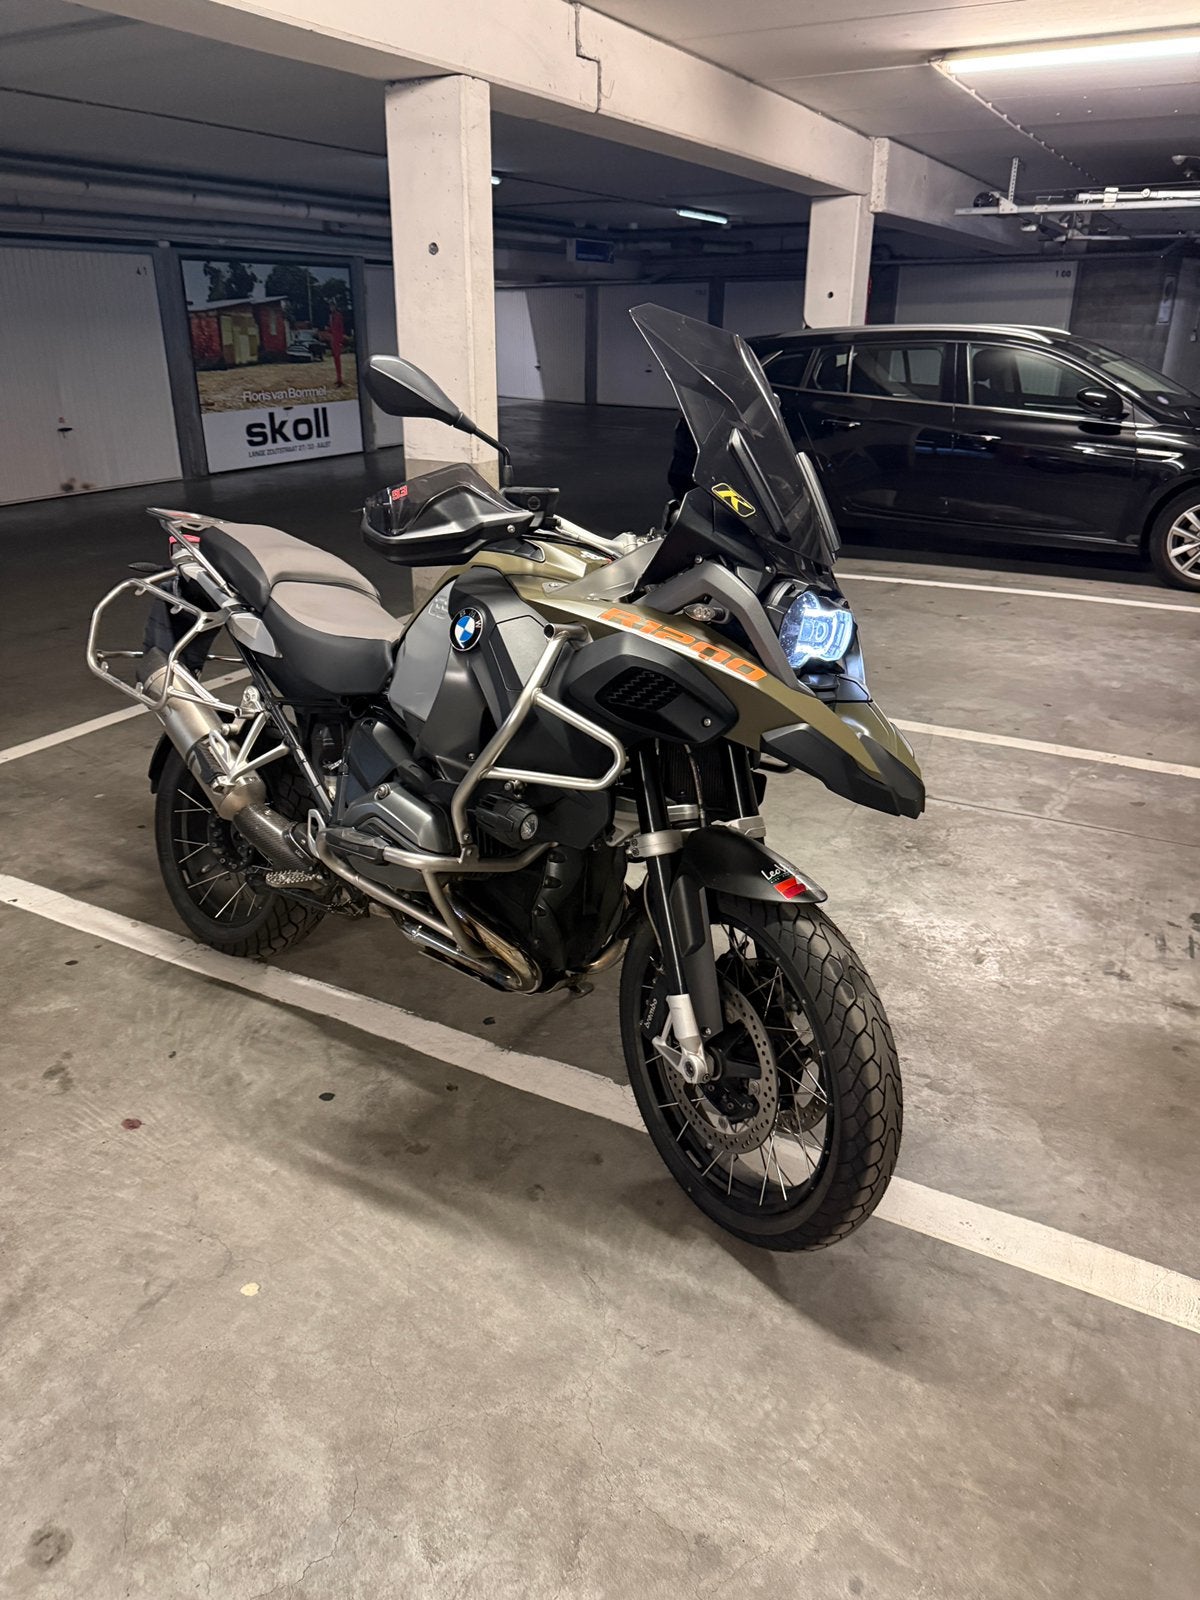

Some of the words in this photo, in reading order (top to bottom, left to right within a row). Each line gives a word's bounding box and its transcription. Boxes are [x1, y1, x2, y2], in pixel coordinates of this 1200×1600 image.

[242, 390, 272, 402] Floris
[271, 389, 288, 400] van
[288, 385, 327, 399] Bommel
[599, 607, 768, 682] R1200
